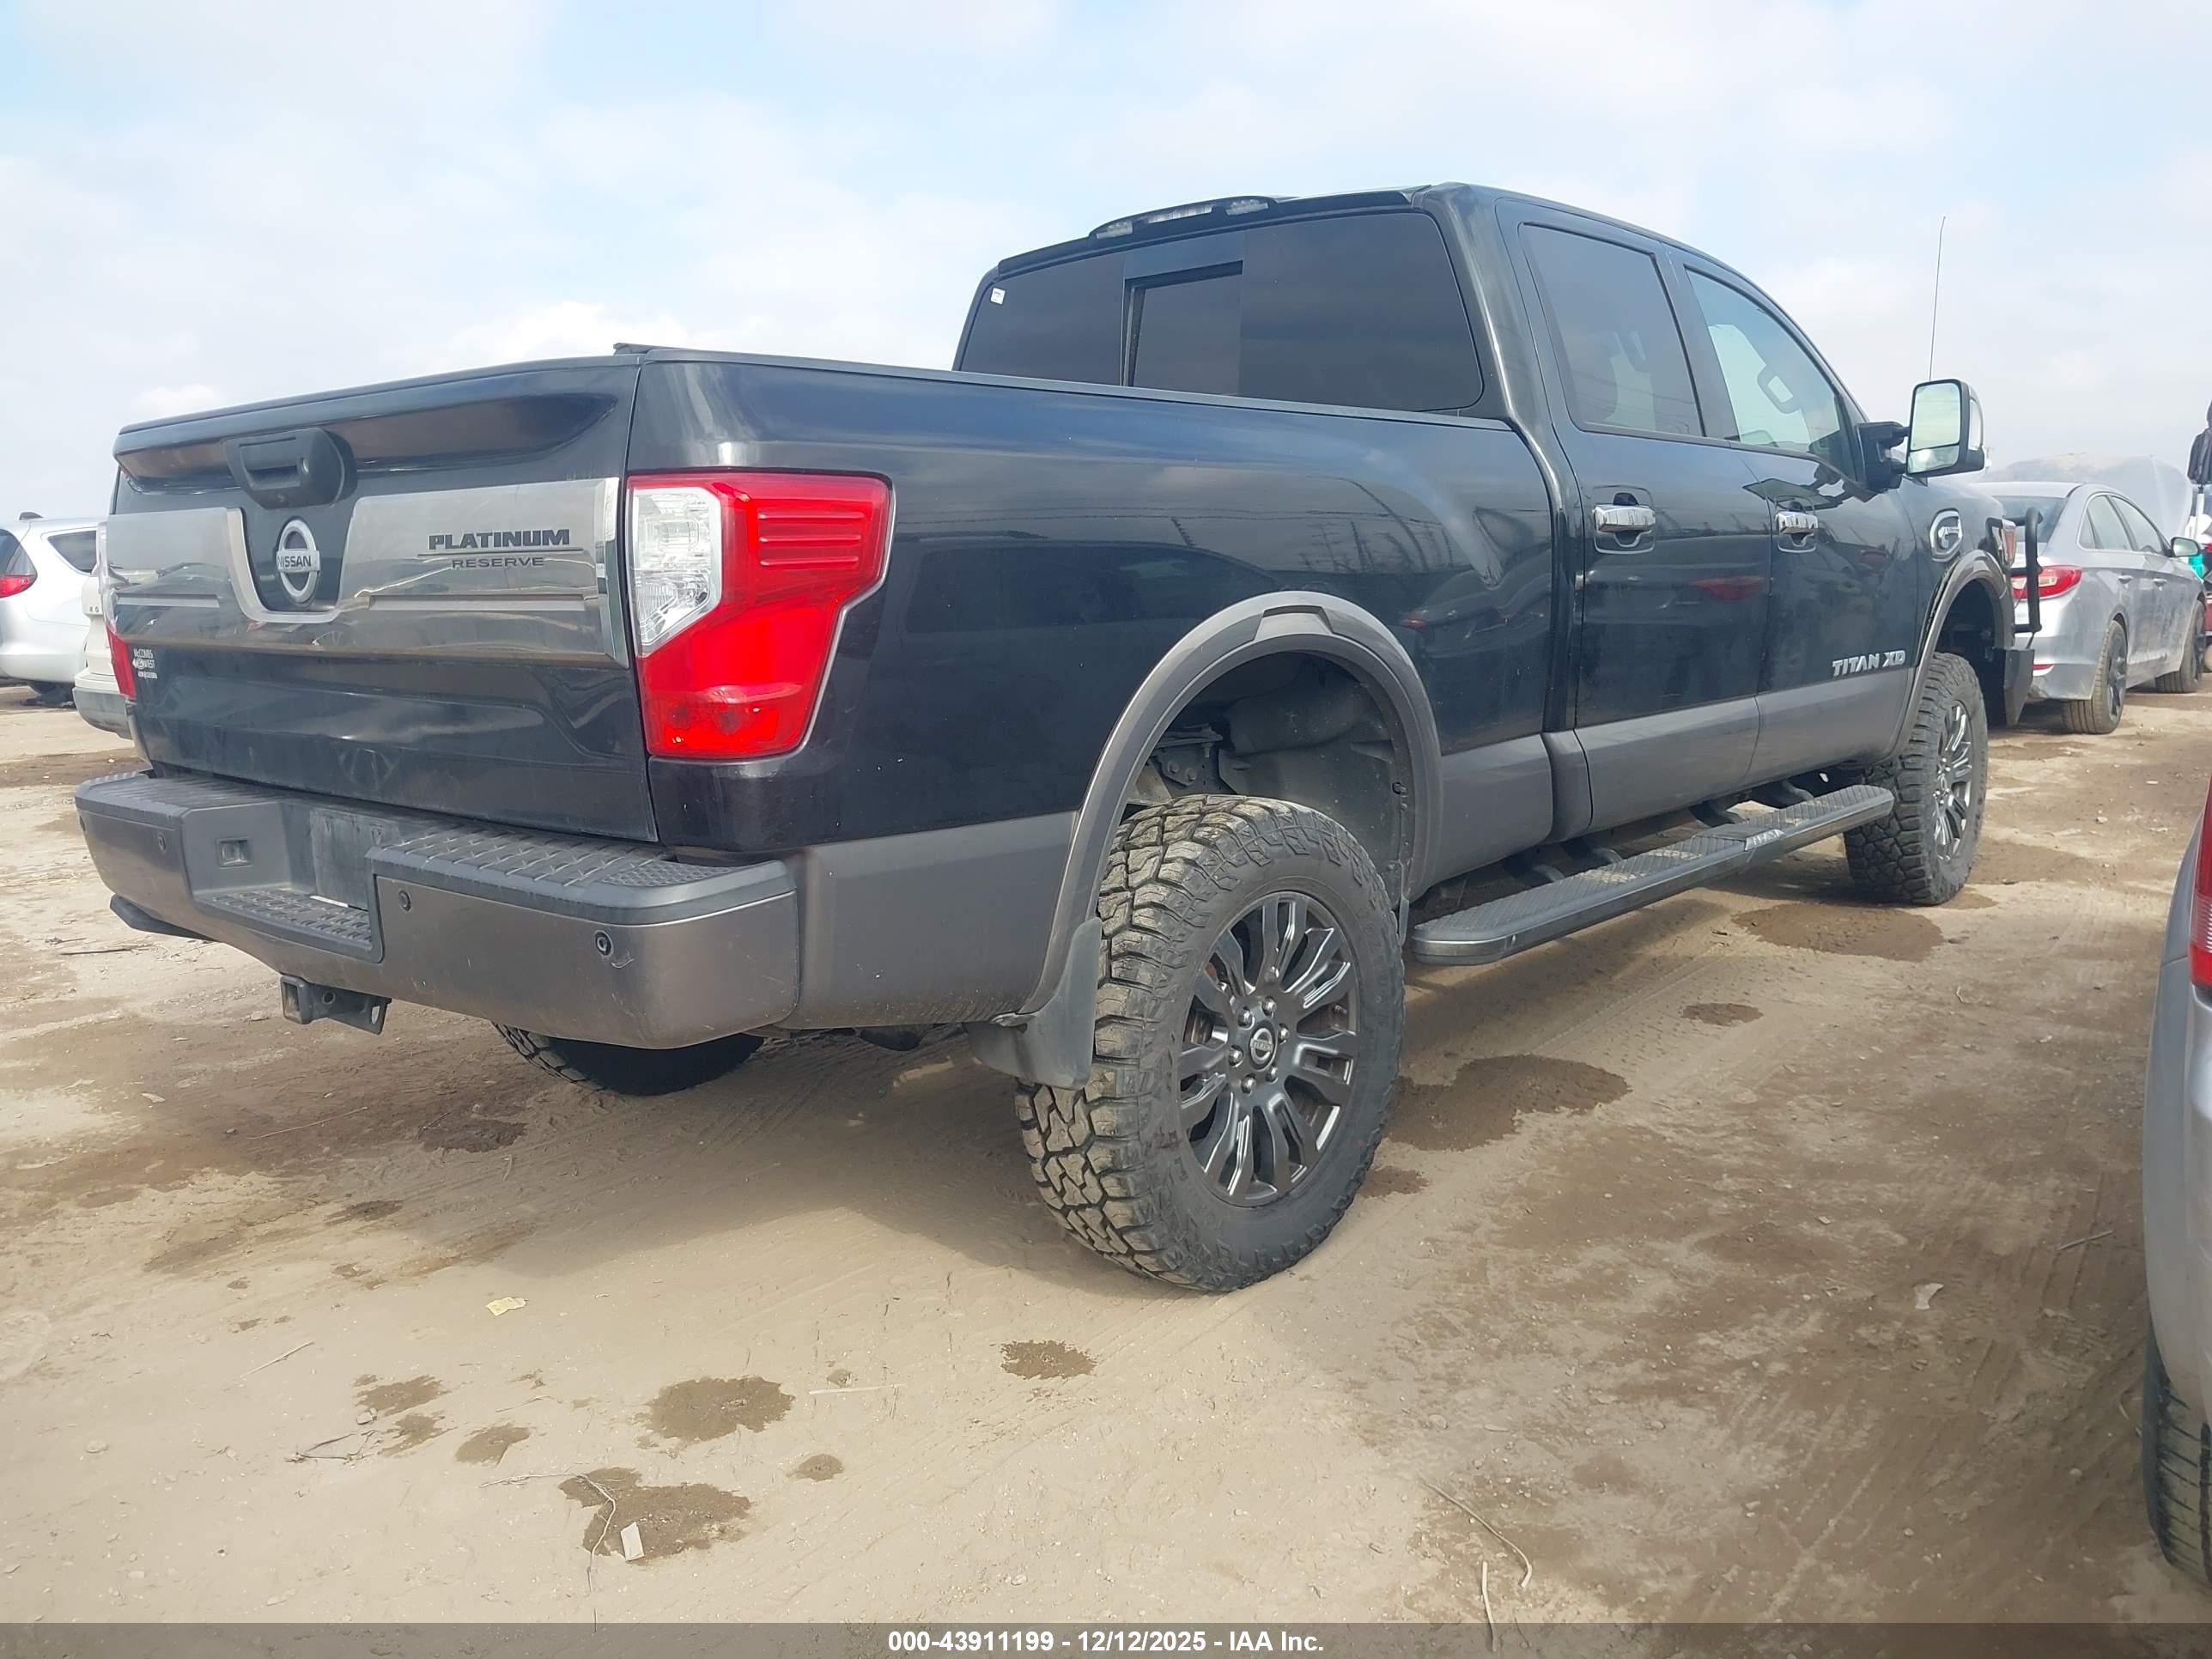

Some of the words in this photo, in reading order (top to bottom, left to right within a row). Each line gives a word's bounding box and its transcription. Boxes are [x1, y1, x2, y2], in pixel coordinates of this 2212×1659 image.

[428, 528, 570, 550] PLATINUM
[277, 555, 312, 568] NISSAN
[452, 556, 544, 568] RESERVE
[1832, 653, 1880, 677] TITAN
[1882, 650, 1905, 668] XD
